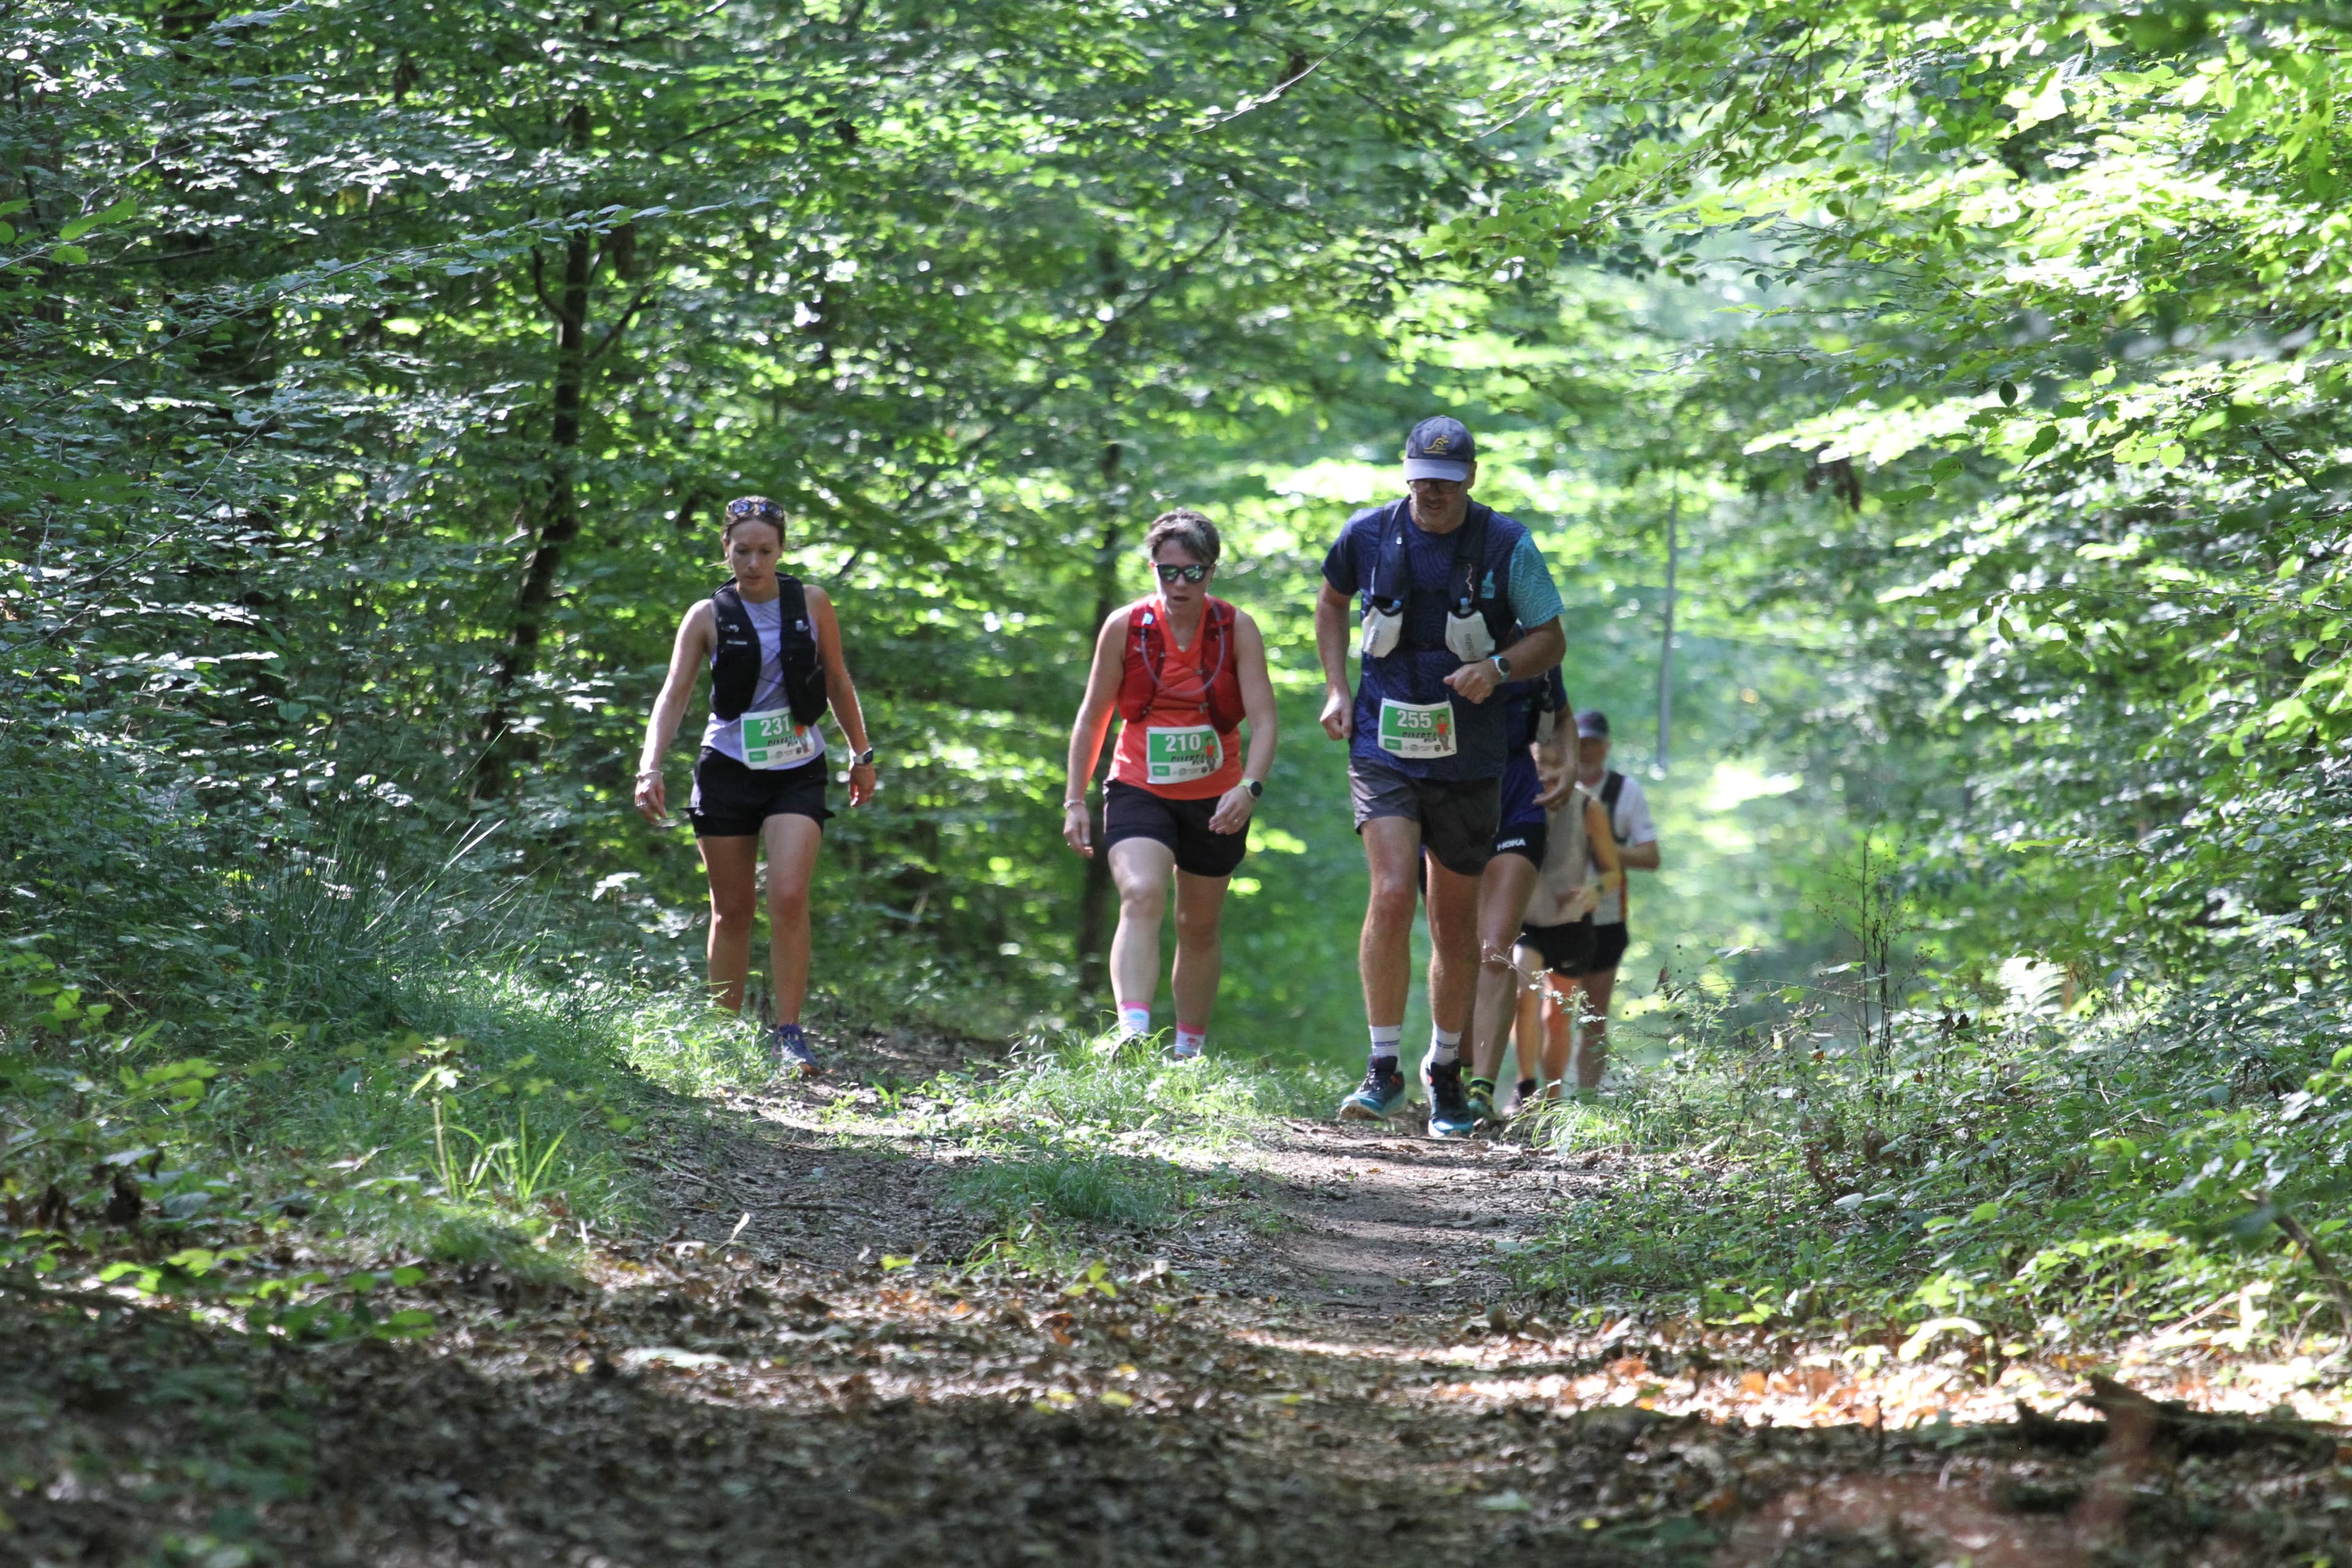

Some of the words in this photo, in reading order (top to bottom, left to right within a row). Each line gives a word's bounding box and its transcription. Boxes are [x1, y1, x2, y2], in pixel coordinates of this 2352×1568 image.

[760, 715, 790, 737] 231
[1397, 710, 1432, 728] 255
[1165, 734, 1201, 752] 210
[1496, 838, 1526, 851] HOKA
